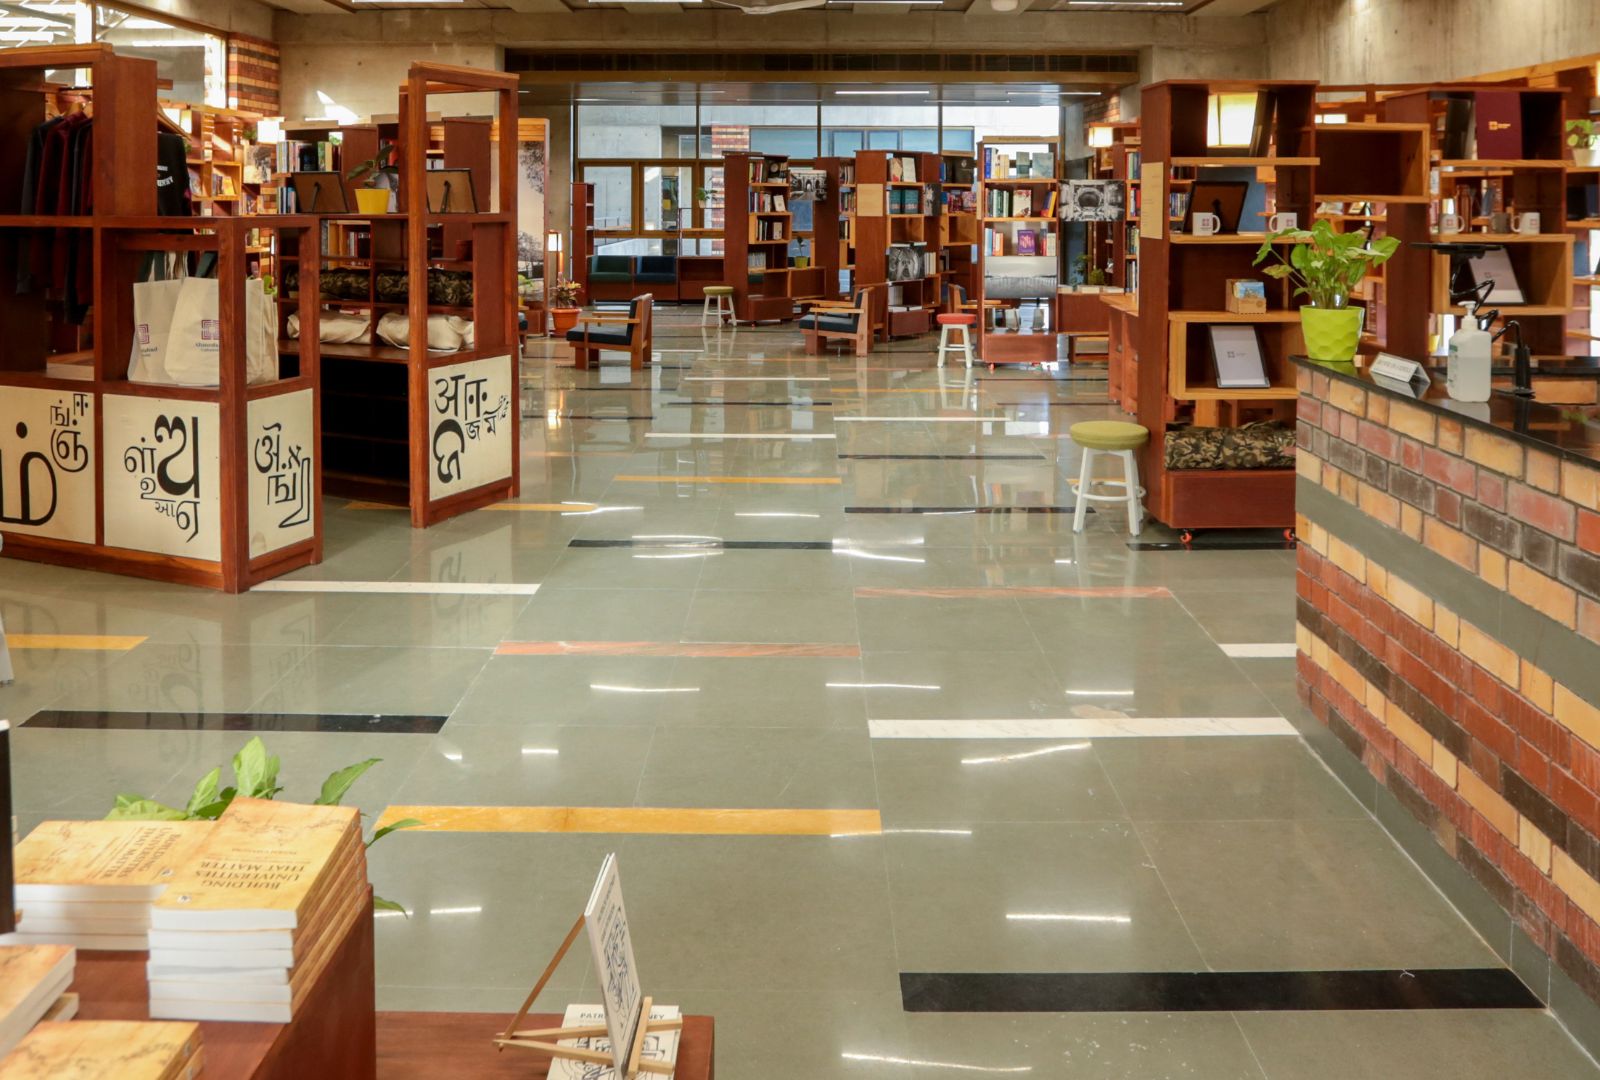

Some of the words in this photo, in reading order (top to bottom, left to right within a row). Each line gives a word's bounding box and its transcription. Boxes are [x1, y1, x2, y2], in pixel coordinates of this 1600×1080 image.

[201, 861, 263, 871] MATTER
[268, 865, 305, 873] THAT
[195, 870, 301, 882] UNIVERSITIES
[202, 880, 281, 890] BUILDING
